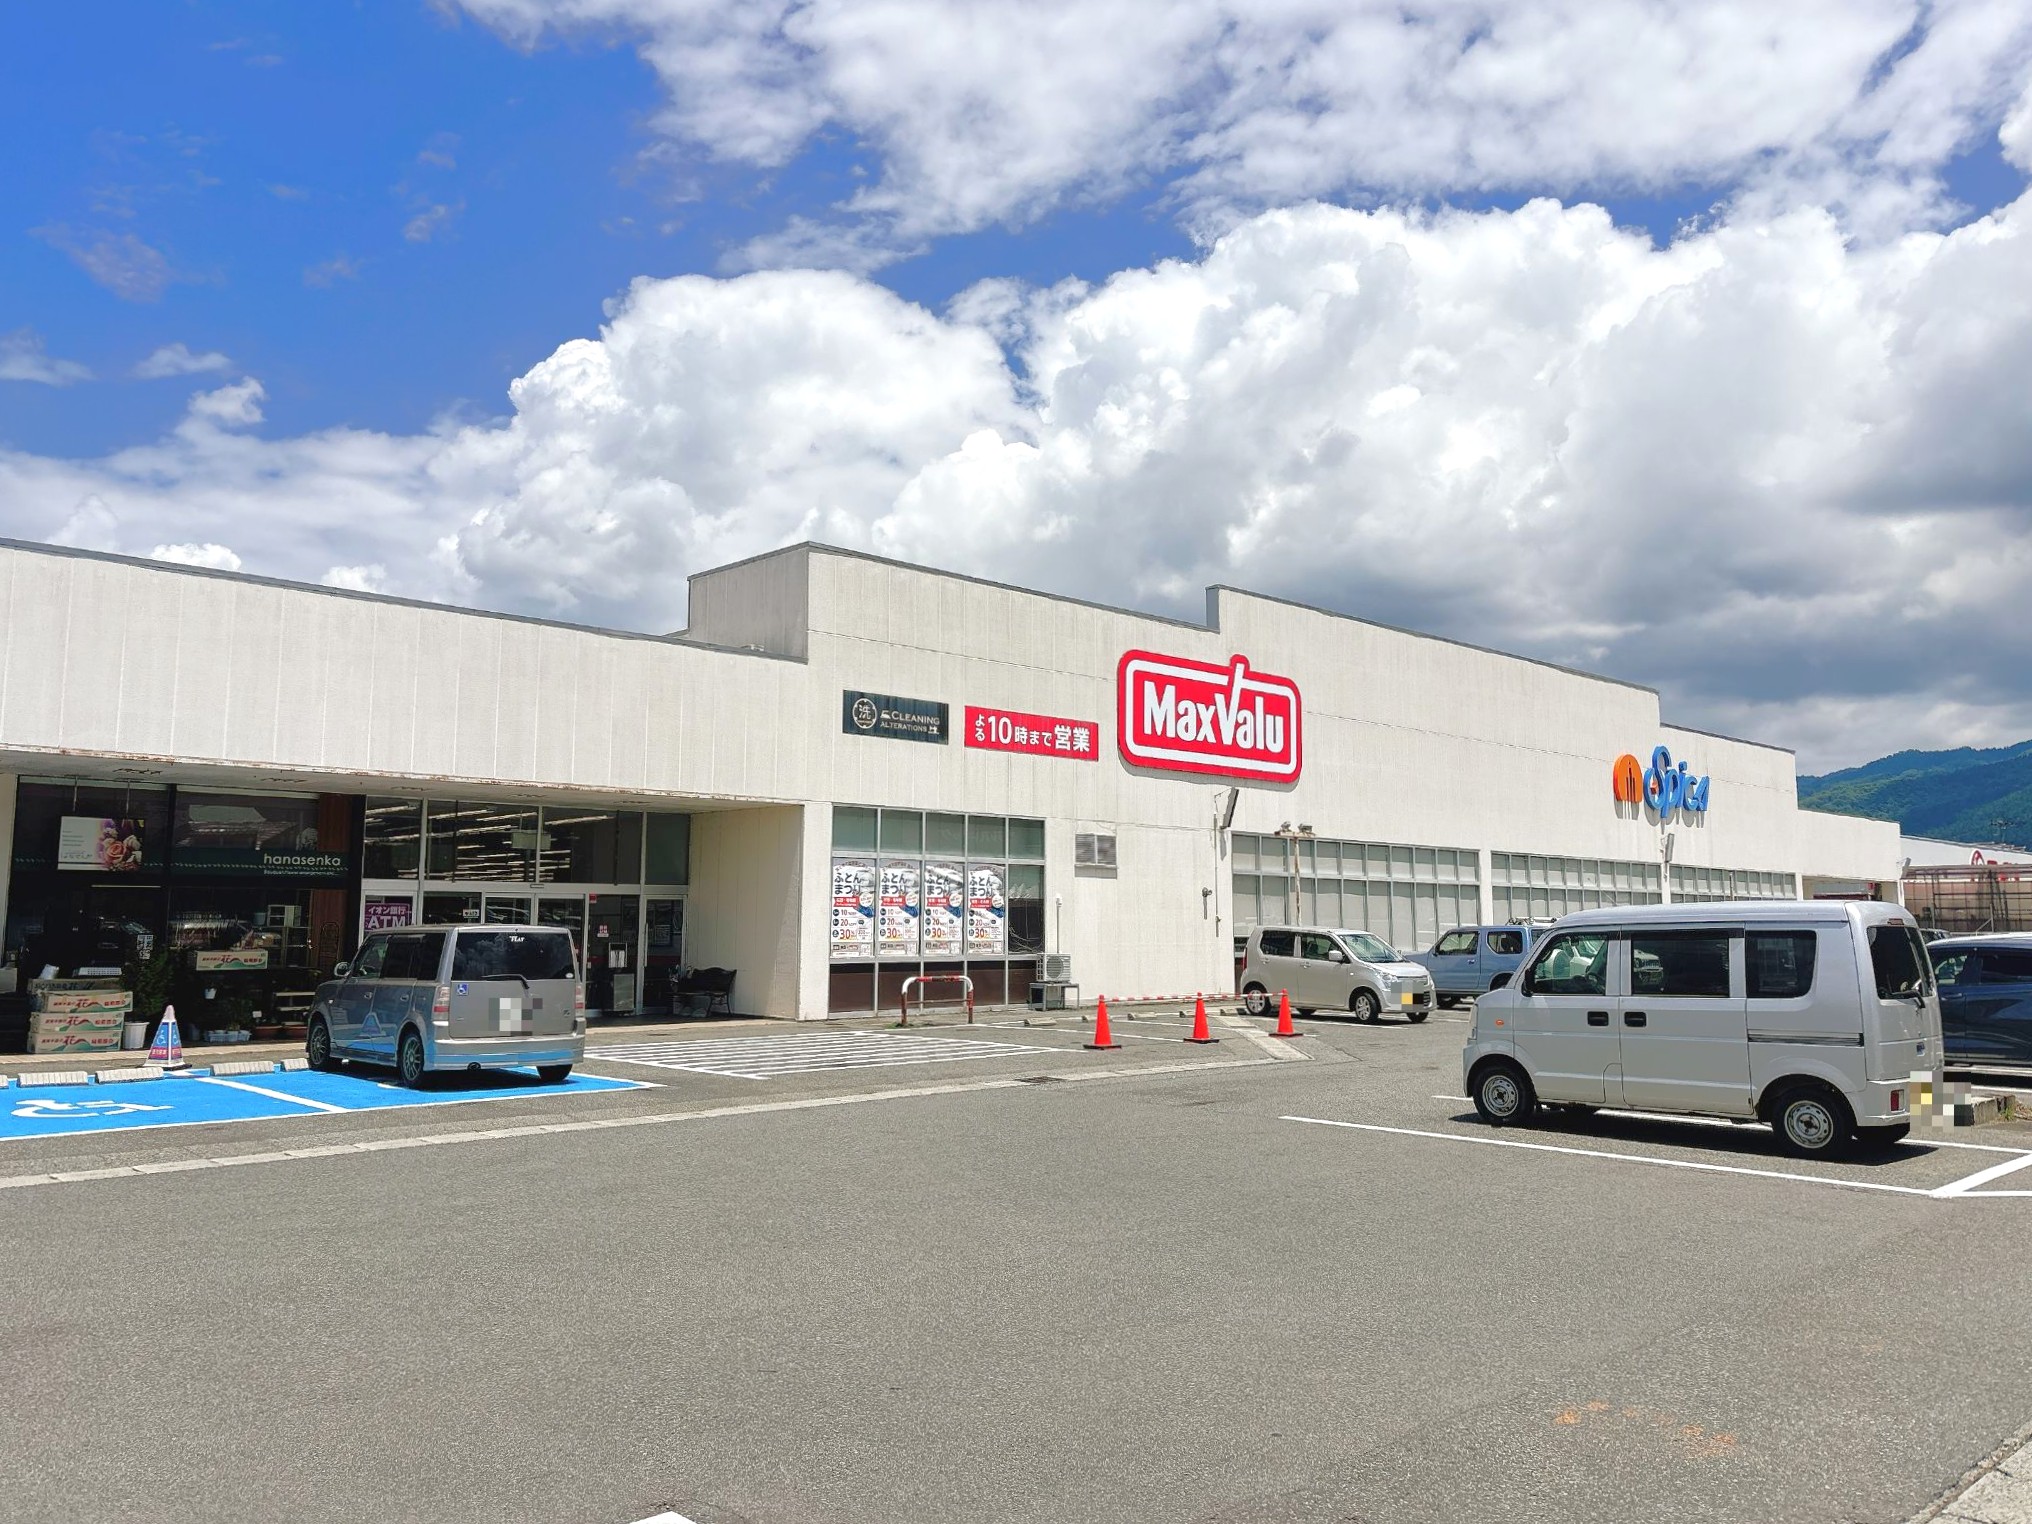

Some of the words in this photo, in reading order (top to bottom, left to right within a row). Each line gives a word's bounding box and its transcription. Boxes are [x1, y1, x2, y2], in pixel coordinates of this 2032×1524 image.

[1144, 663, 1284, 753] MaxValu
[892, 710, 940, 725] CLEANING
[880, 721, 927, 733] ALTERATIONS
[263, 853, 341, 866] hanasenka
[368, 915, 406, 929] ATM
